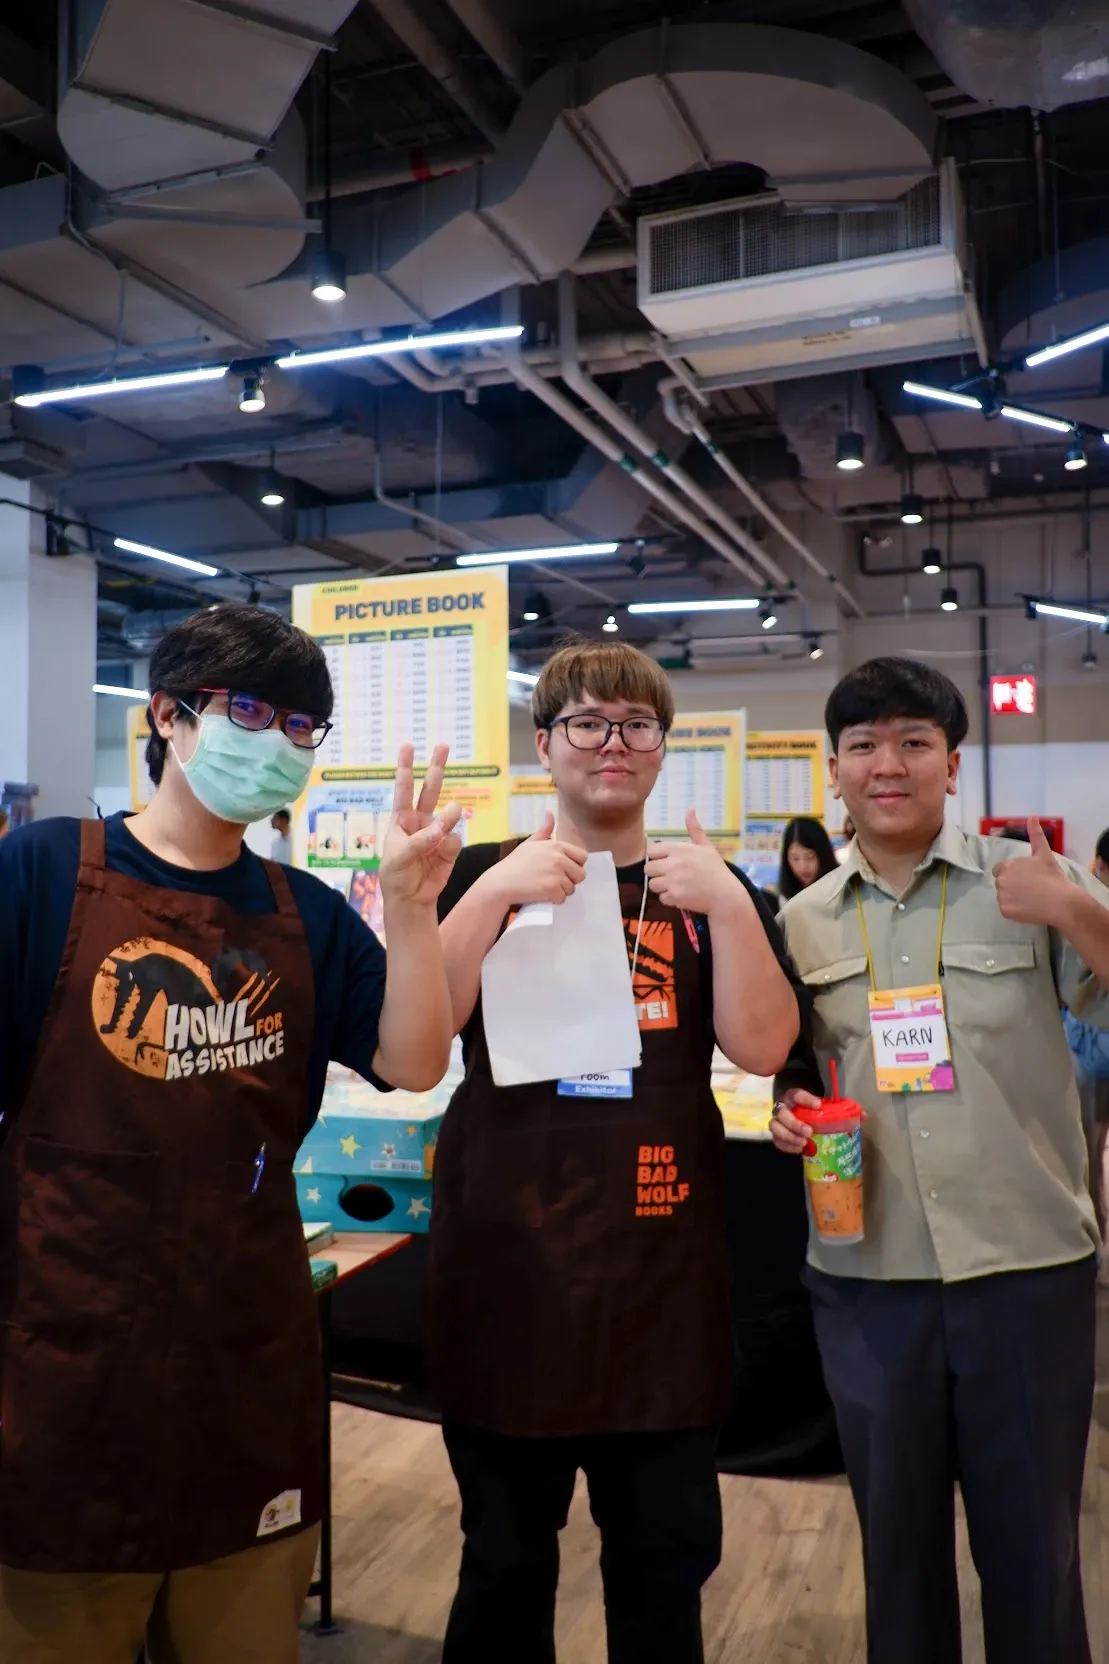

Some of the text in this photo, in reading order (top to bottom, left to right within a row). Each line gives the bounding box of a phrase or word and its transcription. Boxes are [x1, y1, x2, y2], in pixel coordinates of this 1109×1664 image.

[335, 591, 486, 621] PICTURE BOOK
[635, 1001, 669, 1020] TE!
[165, 998, 283, 1051] HOWL FOR
[882, 1026, 933, 1047] KARN
[165, 1030, 284, 1080] ASSISTANCE
[575, 1085, 617, 1094] Exhibitor
[638, 1145, 674, 1164] BIG
[637, 1165, 678, 1184] BAD
[637, 1183, 690, 1204] WOLF
[635, 1205, 673, 1216] BOOKS
